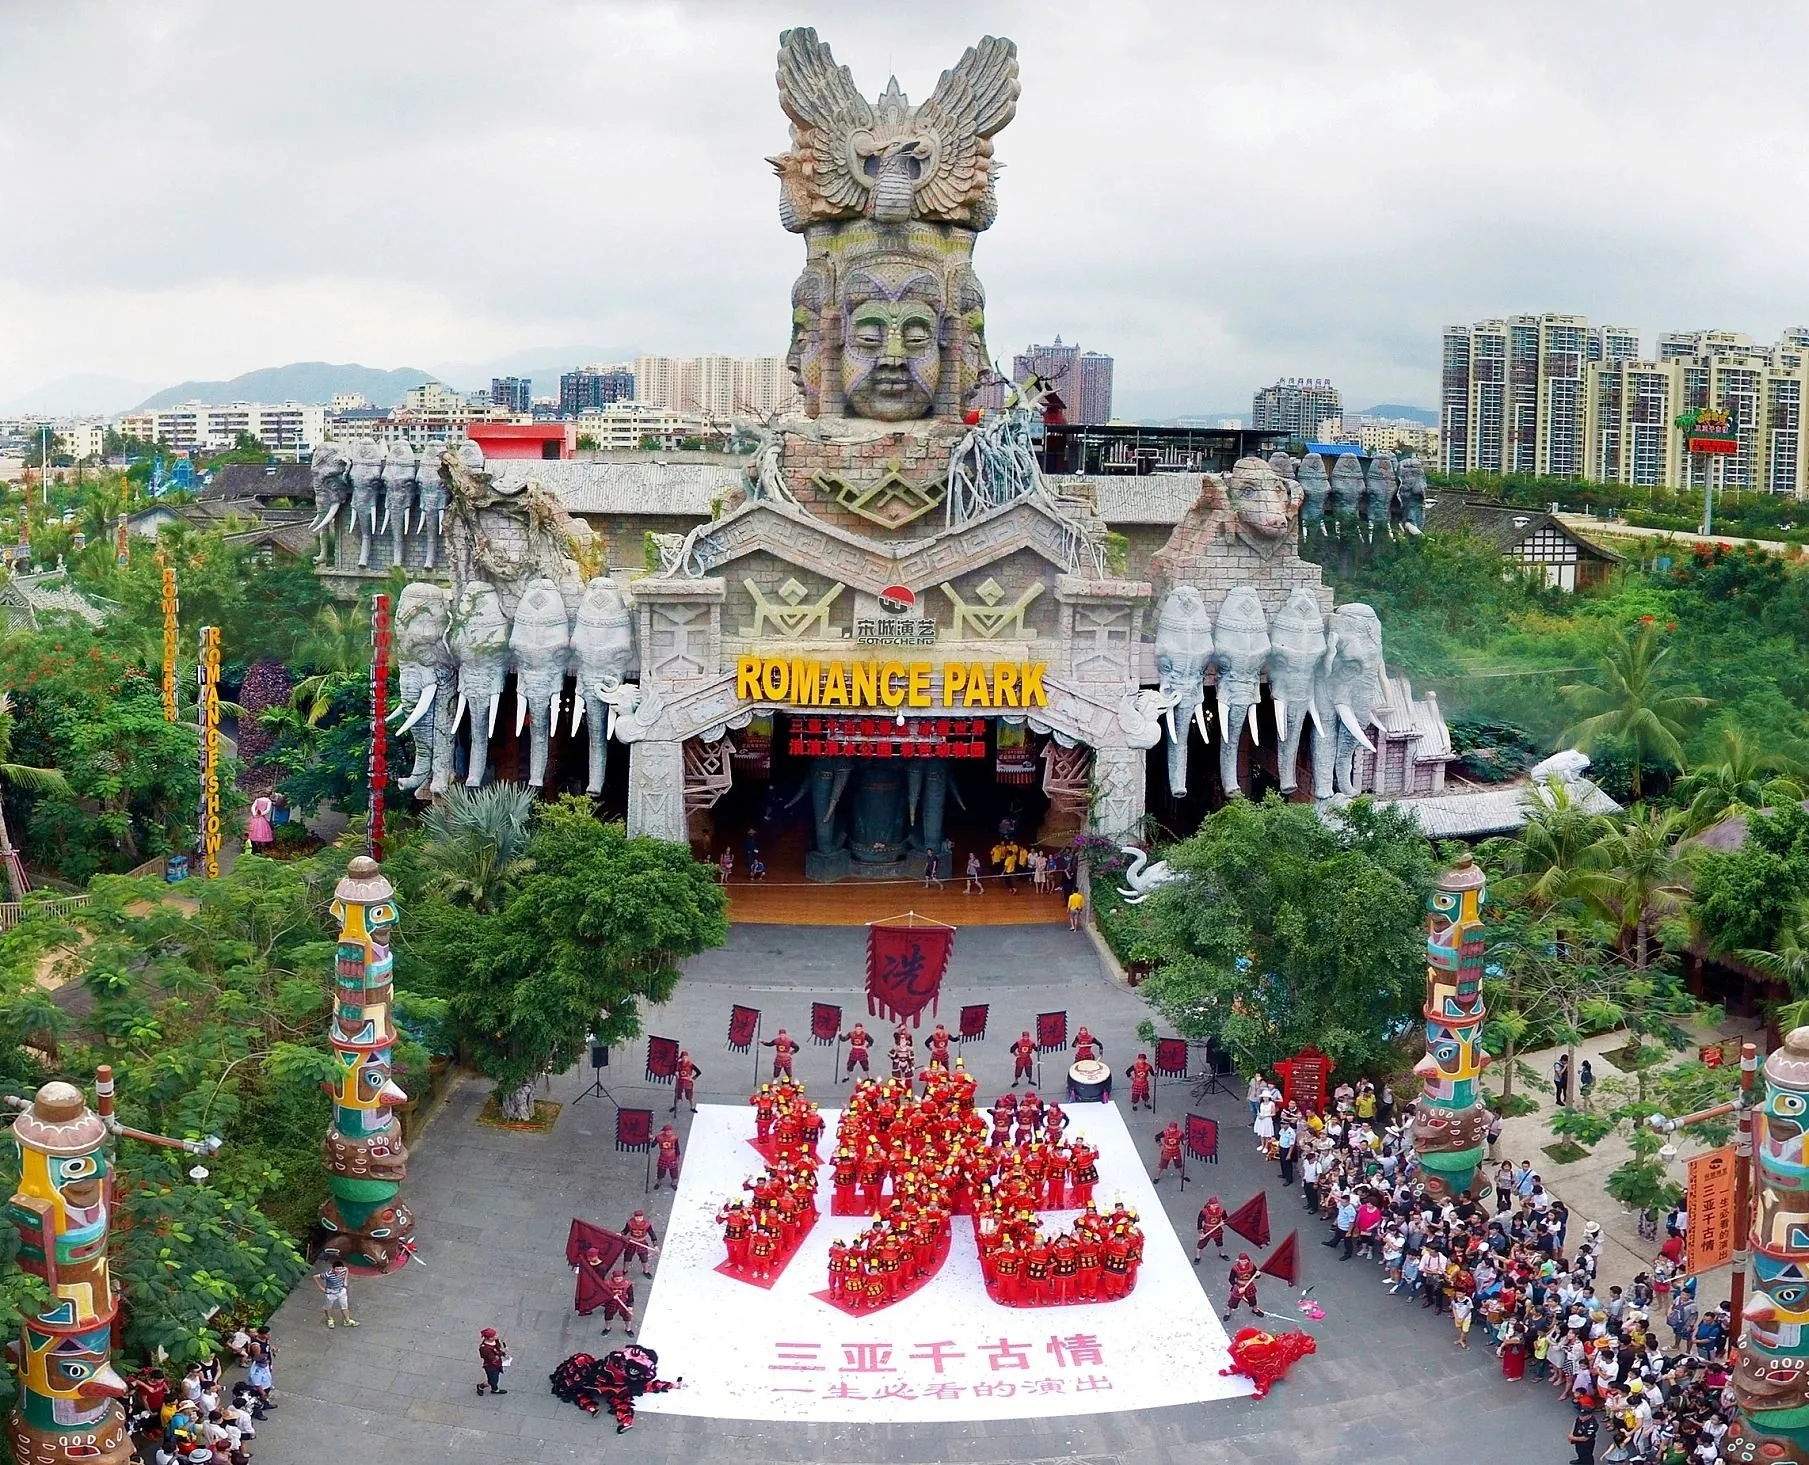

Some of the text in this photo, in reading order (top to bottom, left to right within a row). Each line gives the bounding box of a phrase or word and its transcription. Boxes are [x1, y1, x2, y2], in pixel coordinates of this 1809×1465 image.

[162, 569, 176, 672] ROMANCE
[857, 618, 936, 636] 宋城演艺
[206, 626, 221, 767] ROMANCE
[737, 656, 1049, 708] ROMANCE PARK
[1700, 1183, 1716, 1253] 三亚千古情
[767, 1333, 1104, 1374] 三亚千古情
[771, 1374, 1113, 1400] 一生必看的演出
